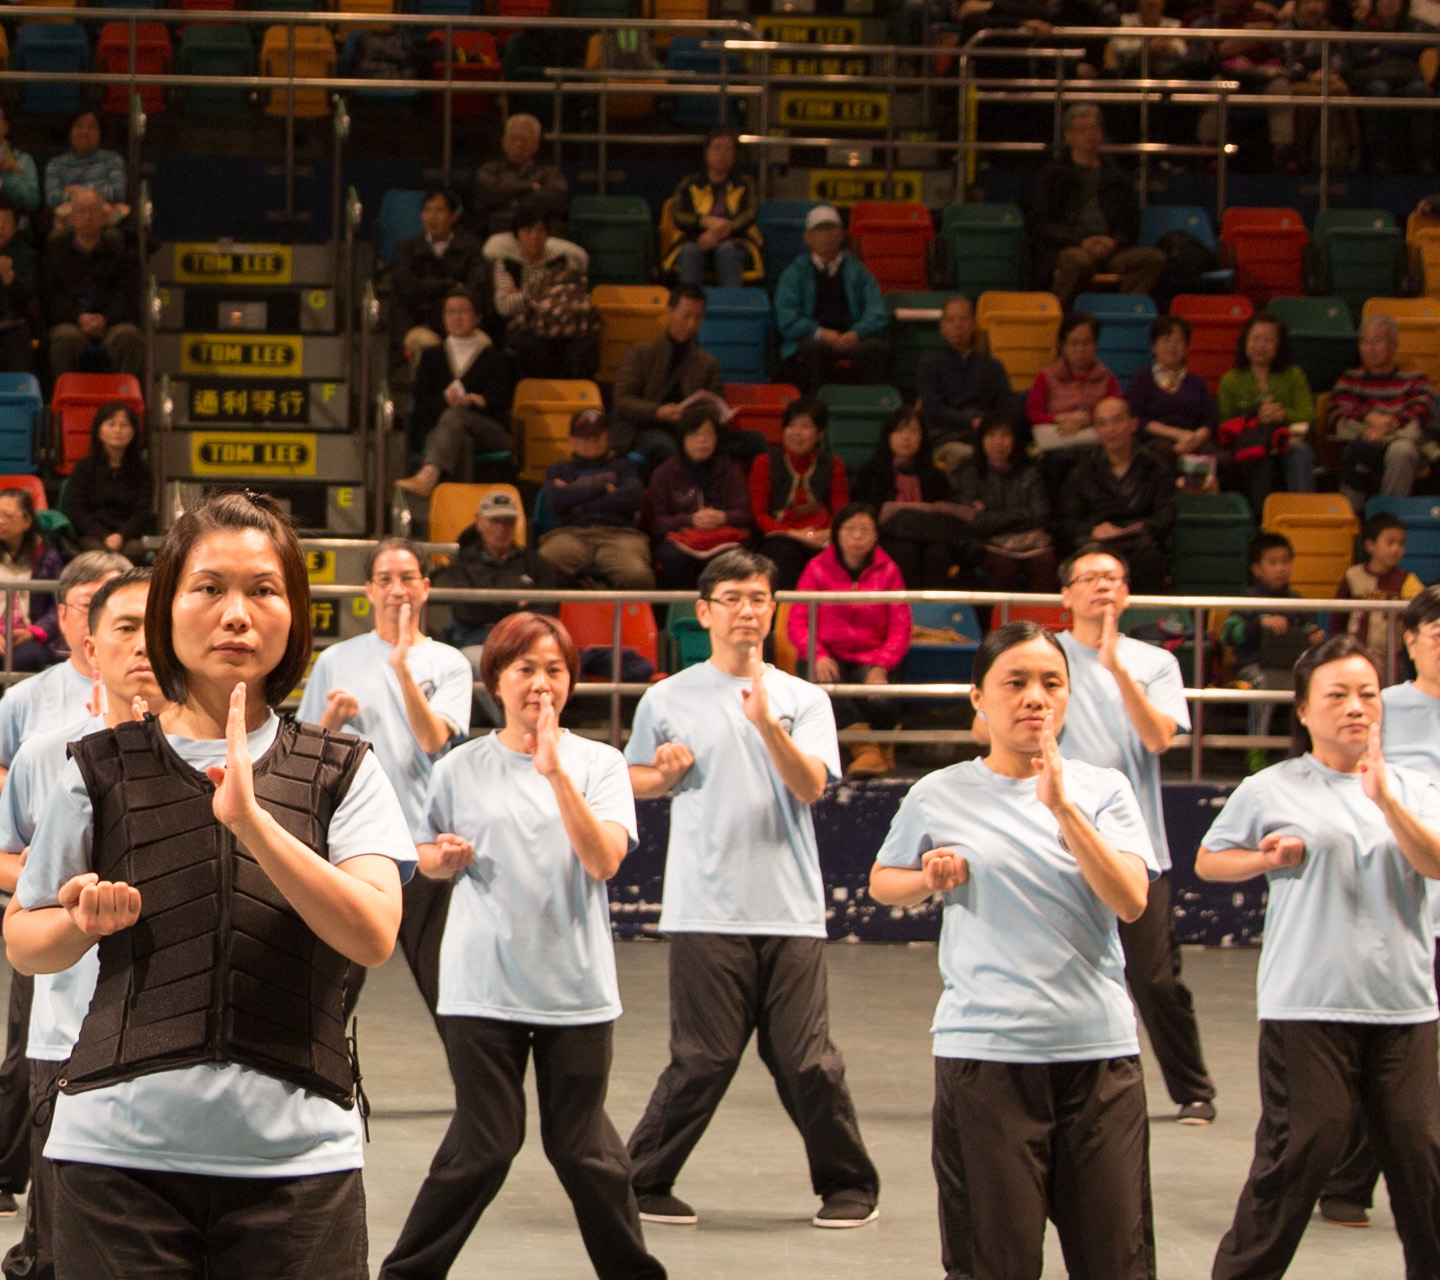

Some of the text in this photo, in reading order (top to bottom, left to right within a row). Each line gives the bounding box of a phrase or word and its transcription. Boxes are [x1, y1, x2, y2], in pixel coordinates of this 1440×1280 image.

[307, 289, 327, 310] G
[211, 443, 301, 465] TOM LEE
